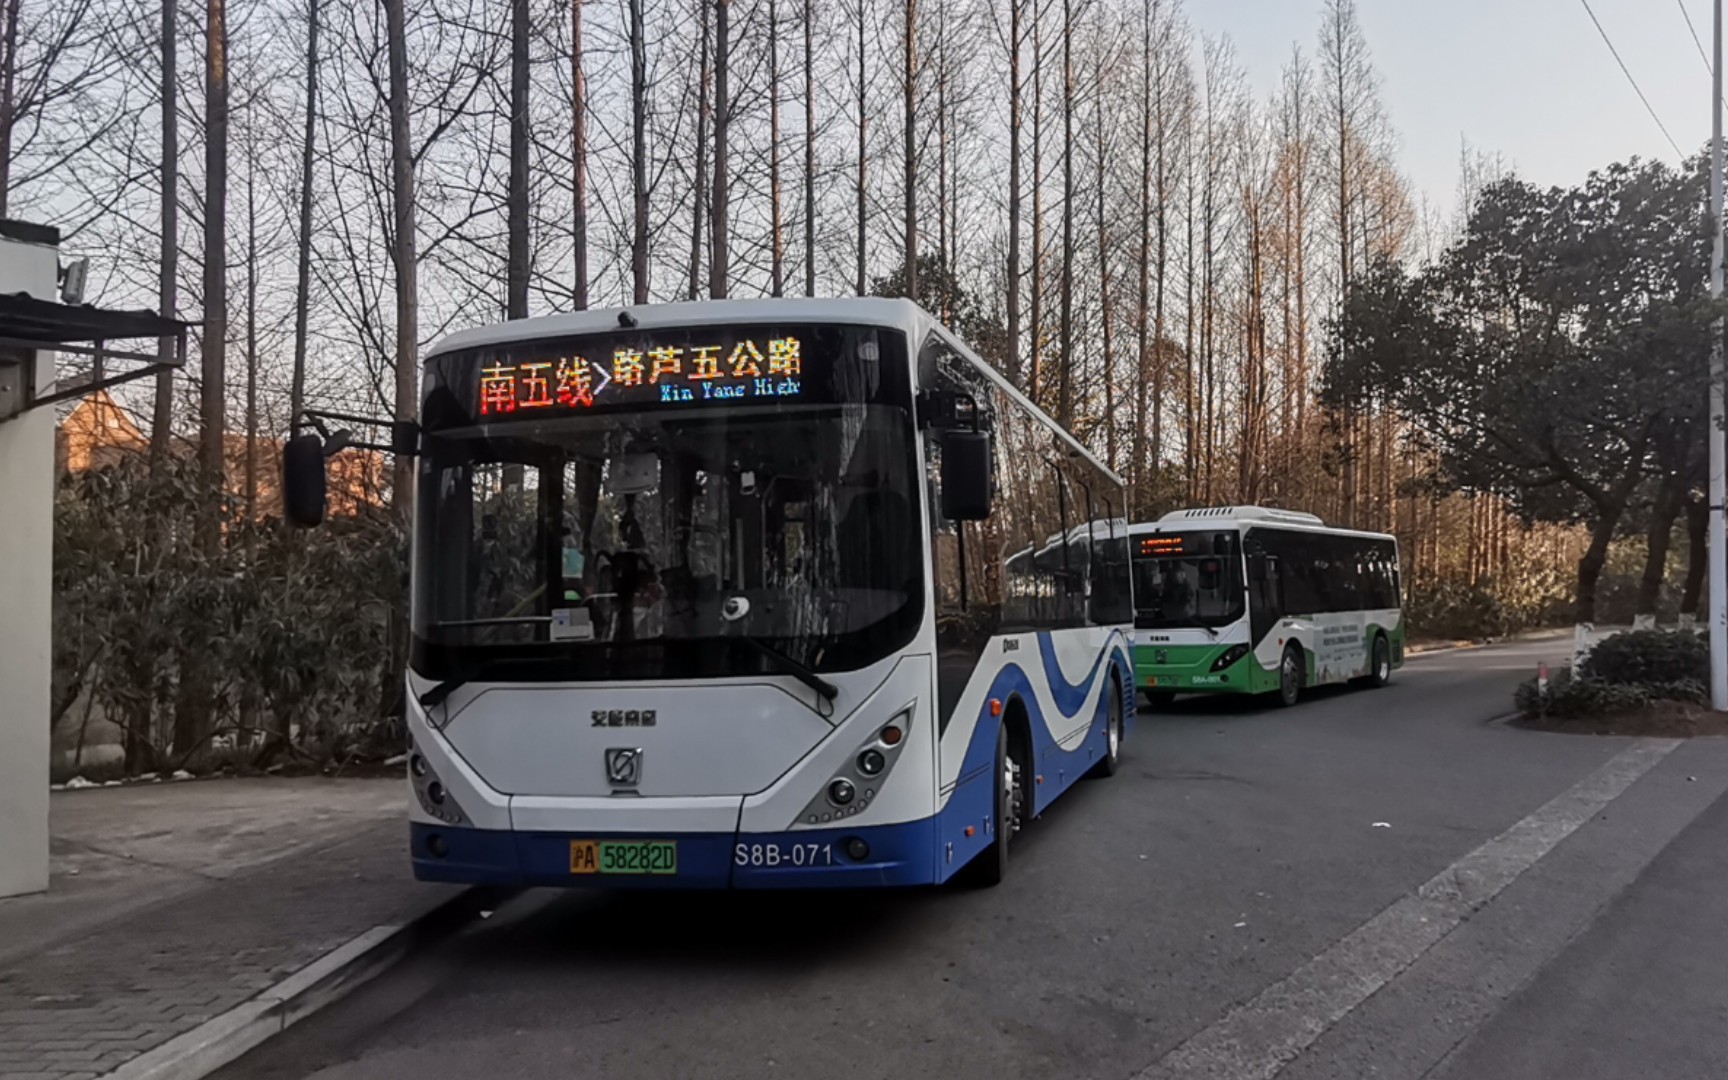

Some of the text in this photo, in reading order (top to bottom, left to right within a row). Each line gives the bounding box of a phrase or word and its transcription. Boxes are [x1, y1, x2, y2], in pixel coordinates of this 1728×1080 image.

[480, 356, 593, 415] 南五线
[660, 384, 694, 402] Xin
[735, 843, 831, 866] S8B-071
